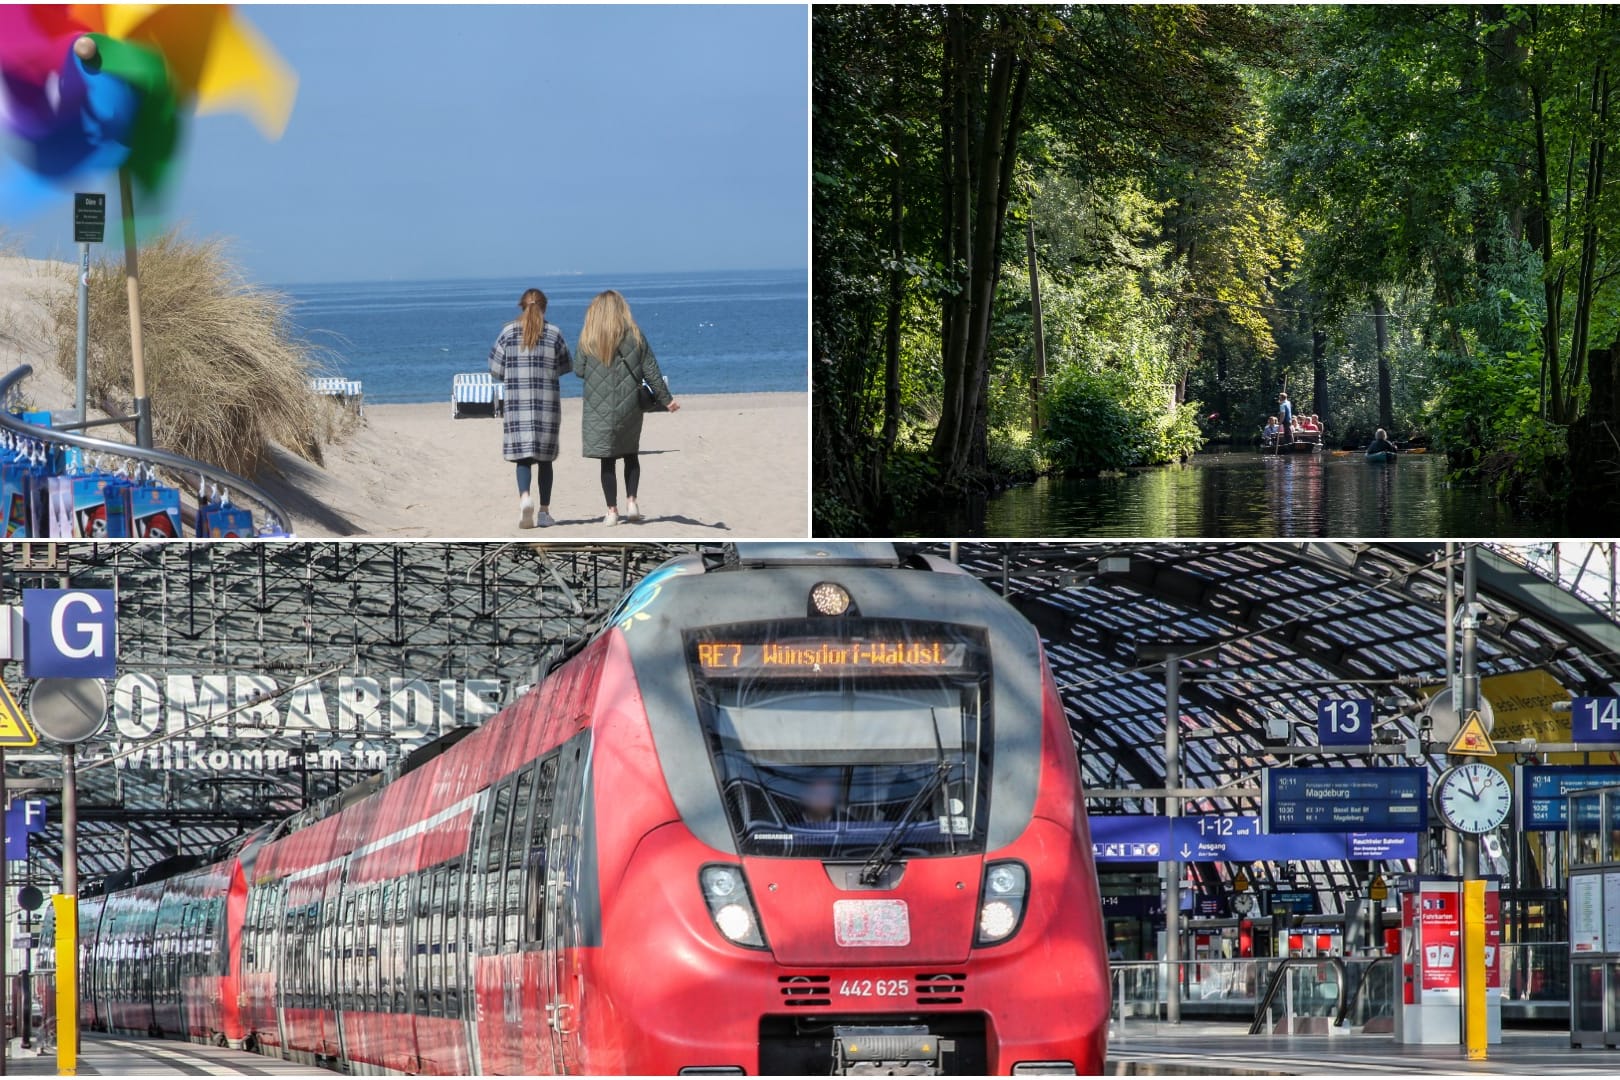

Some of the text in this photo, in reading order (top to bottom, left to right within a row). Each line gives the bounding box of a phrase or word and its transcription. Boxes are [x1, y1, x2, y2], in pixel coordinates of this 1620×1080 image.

[51, 592, 103, 658] G
[698, 643, 946, 668] RE7 Wünsdorf-Waldst.
[98, 673, 501, 738] OMBARDIE
[1324, 700, 1360, 734] 13
[1585, 699, 1620, 731] 14
[352, 741, 388, 771] in
[1306, 788, 1350, 799] Magdeburg
[25, 800, 41, 825] F
[1197, 818, 1261, 836] 1-12 und 1
[1198, 843, 1226, 851] Ausgang
[839, 980, 909, 996] 442 625
